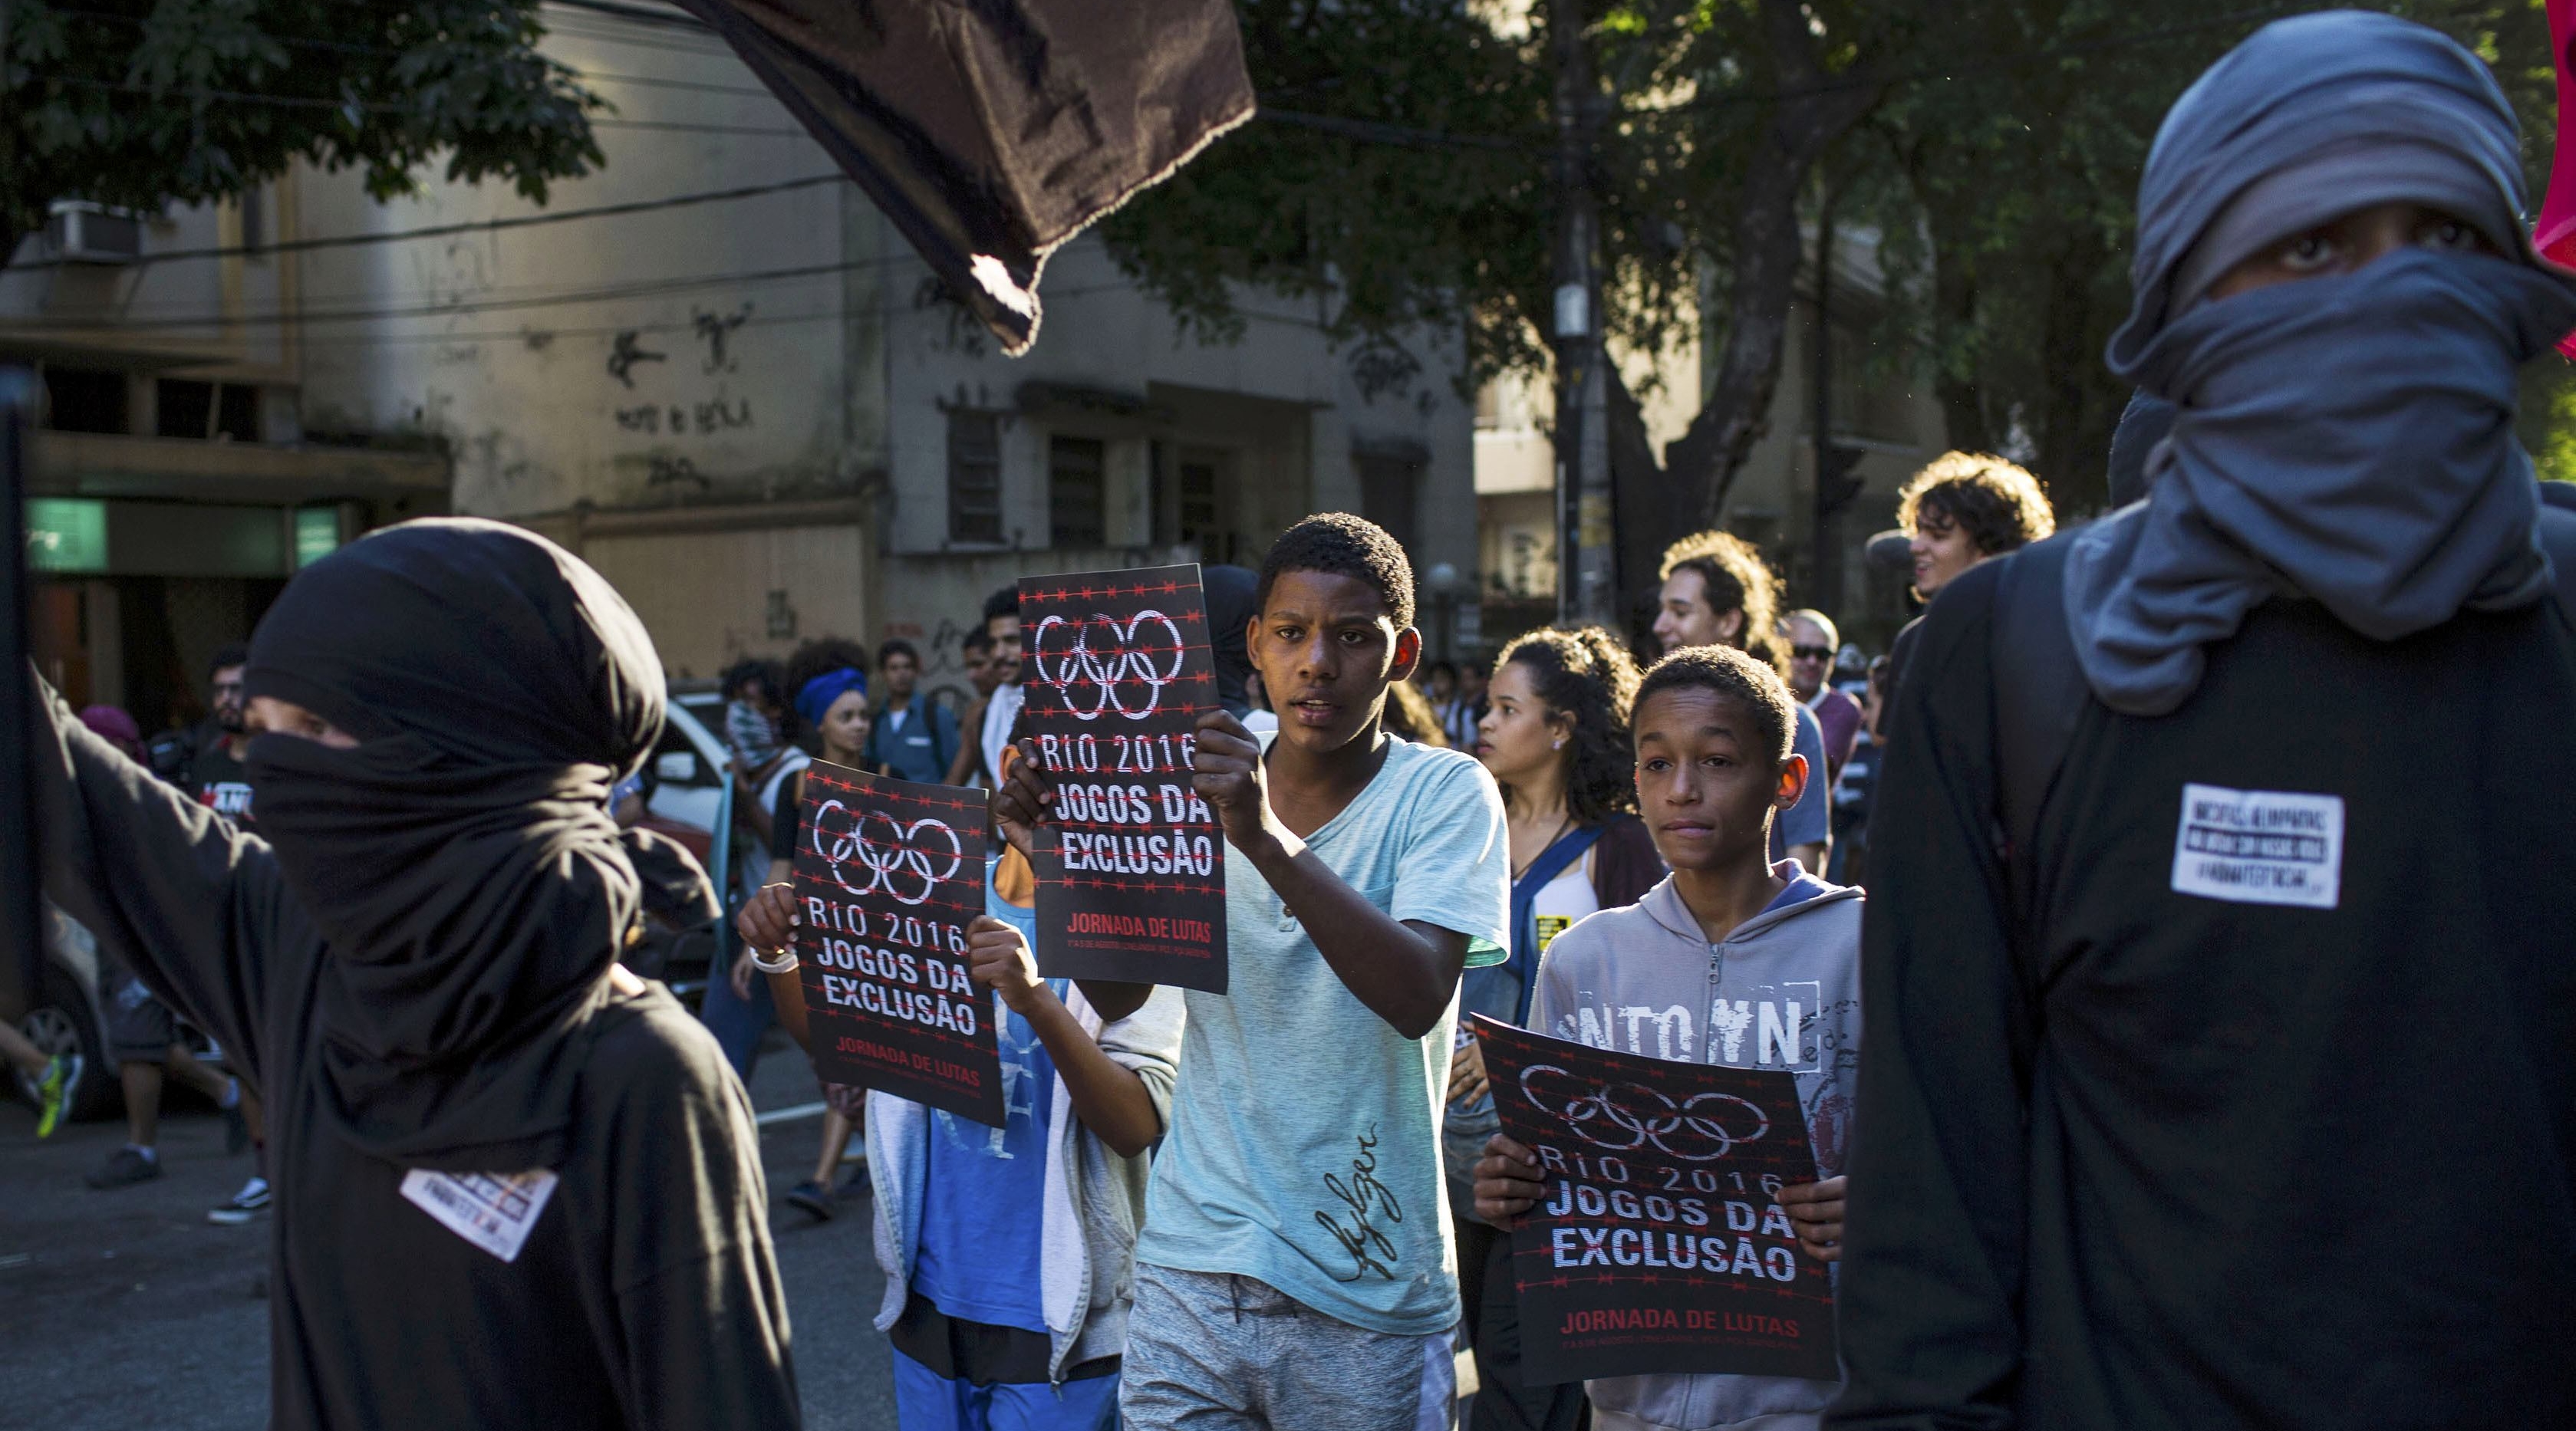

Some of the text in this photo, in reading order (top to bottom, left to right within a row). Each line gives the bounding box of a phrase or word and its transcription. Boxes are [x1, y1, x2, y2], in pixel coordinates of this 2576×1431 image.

[1040, 734, 1097, 772] RIO
[1055, 784, 1212, 824] JOGOS DA
[1062, 830, 1213, 877] EXCLUSÃO
[808, 896, 967, 956] RIO 2016
[1067, 913, 1211, 943] JORNADA DE LUTAS
[816, 937, 973, 997] JOGOS DA
[823, 975, 977, 1036] EXCLUSÃO
[836, 1037, 909, 1066] JORNADA
[911, 1053, 933, 1072] DE
[934, 1059, 980, 1087] LUTAS
[1539, 1145, 1778, 1198] RIO 2016
[1547, 1179, 1796, 1239] JOGOS DA
[1553, 1228, 1797, 1281] EXCLUSÃO
[1560, 1309, 1800, 1338] JORNADA DE LUTAS
